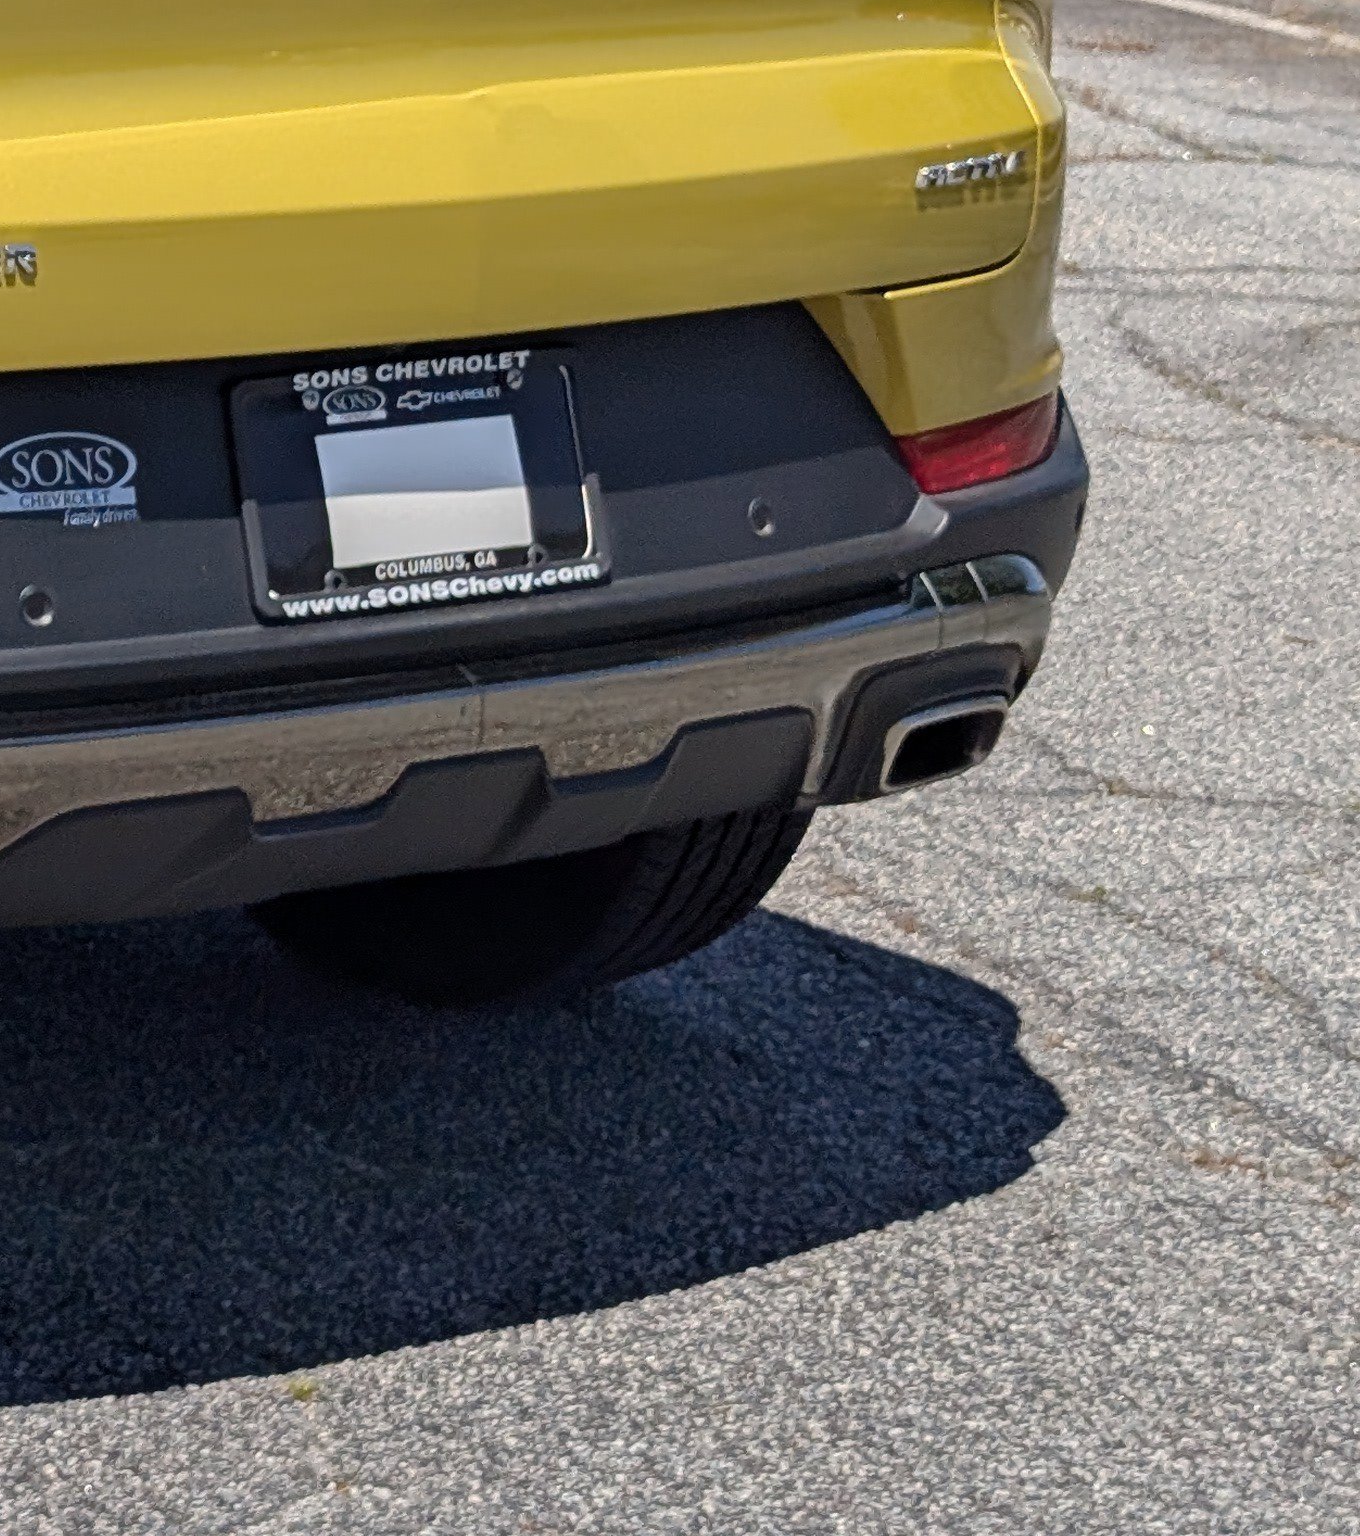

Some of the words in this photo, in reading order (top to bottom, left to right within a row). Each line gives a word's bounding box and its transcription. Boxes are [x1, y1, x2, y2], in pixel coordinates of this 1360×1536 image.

[292, 365, 369, 393] SONS
[374, 348, 531, 384] CHEVROLET
[433, 384, 502, 405] CHEVROLET
[11, 445, 115, 489] SONS
[18, 490, 112, 508] CHEVROLET
[375, 552, 471, 581] COLUMBUS,
[474, 549, 498, 569] GA
[282, 562, 600, 619] www.SONSChevy.com
